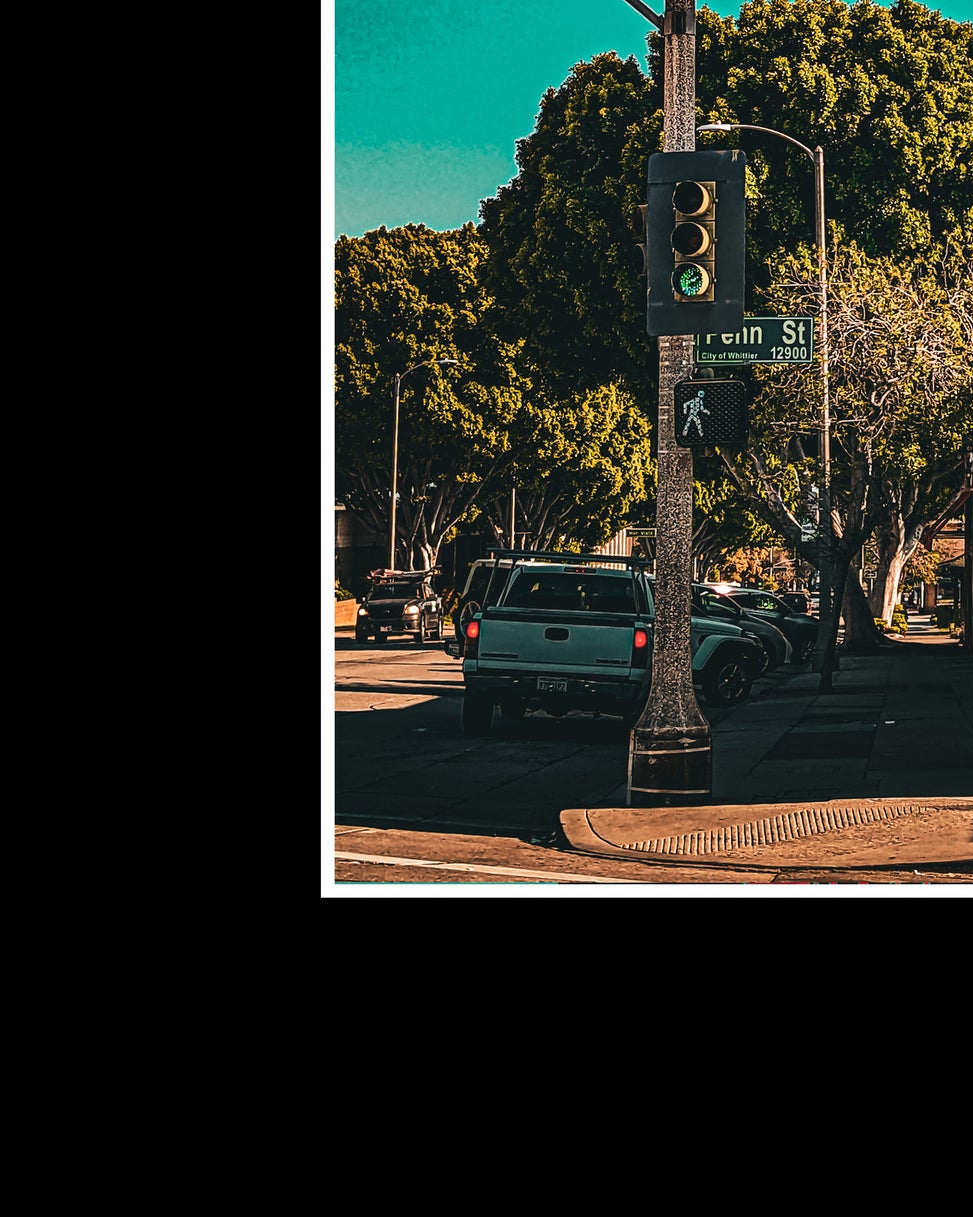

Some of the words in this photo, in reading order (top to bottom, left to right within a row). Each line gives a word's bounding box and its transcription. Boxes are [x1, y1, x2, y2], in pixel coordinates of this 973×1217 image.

[782, 320, 806, 345] St
[701, 352, 716, 361] City
[718, 352, 726, 360] of
[727, 352, 758, 360] Whittier
[770, 346, 807, 360] 12900
